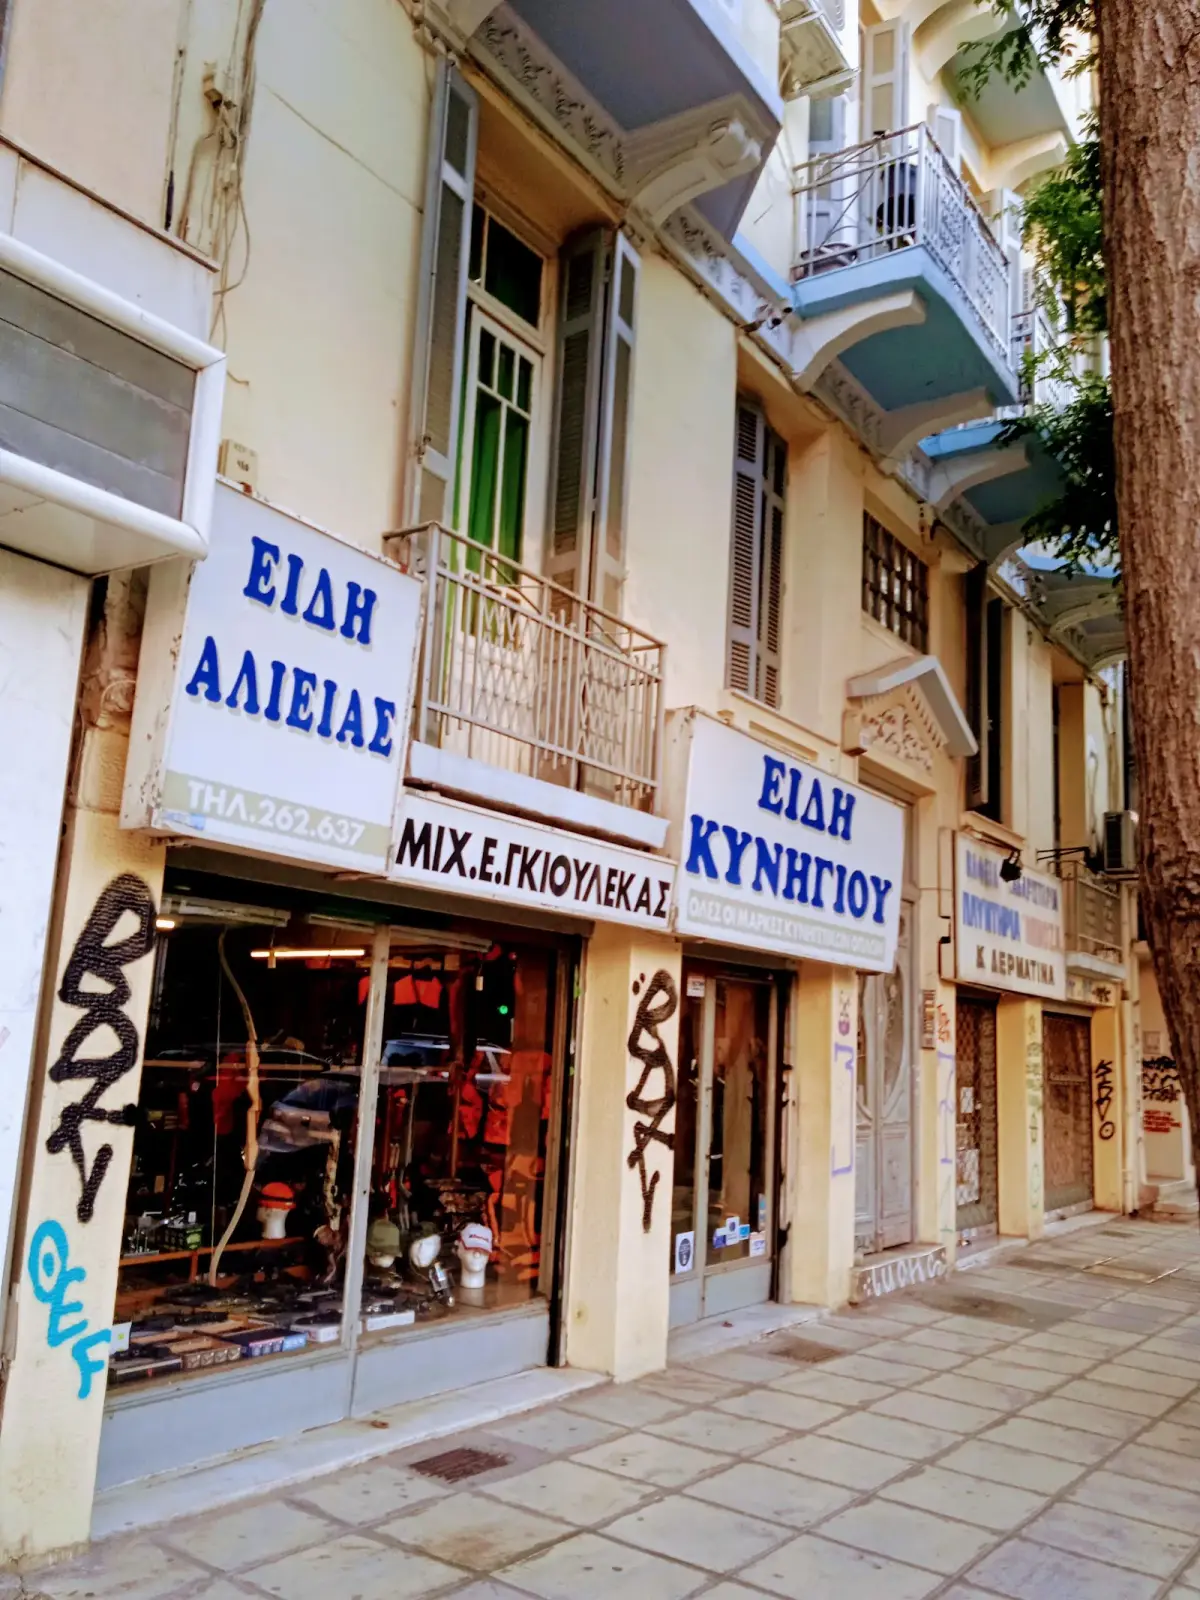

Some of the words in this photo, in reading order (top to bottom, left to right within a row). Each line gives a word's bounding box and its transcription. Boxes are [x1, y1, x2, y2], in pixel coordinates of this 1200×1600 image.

[243, 536, 377, 645] ΕΙΔΗ
[185, 636, 396, 757] ΑΛΙΕΙΑΣ
[187, 780, 366, 846] ΤΗΛ.262.637
[758, 754, 856, 841] ΕΙΔΗ
[685, 814, 892, 923] ΚΥΝΗΓΙΟΥ
